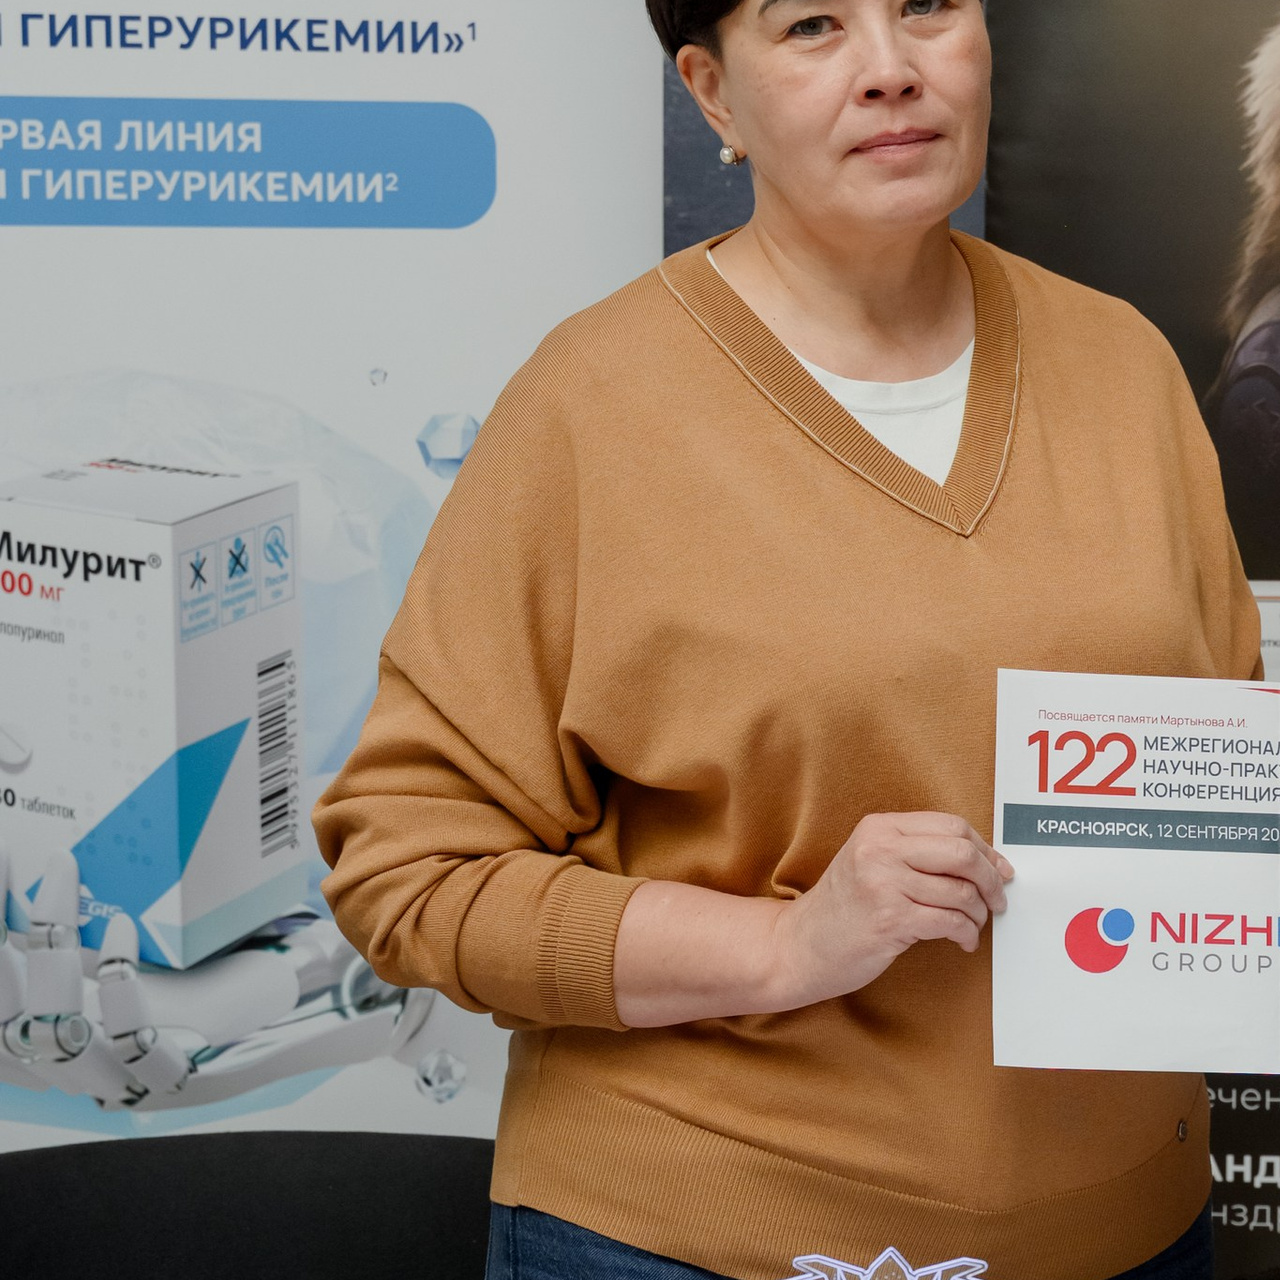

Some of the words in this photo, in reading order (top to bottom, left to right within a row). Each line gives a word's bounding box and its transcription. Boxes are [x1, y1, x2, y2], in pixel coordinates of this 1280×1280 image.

[115, 122, 262, 153] ЛИНИЯ
[1038, 709, 1115, 726] Посвящается
[1116, 713, 1160, 727] памяти
[1160, 714, 1224, 730] Мартынова
[1226, 717, 1249, 729] А.И.
[1027, 729, 1137, 797] 122
[0, 787, 16, 807] 0
[20, 795, 77, 821] таблеток
[1036, 818, 1154, 841] КРАСНОЯРСК,
[1157, 823, 1174, 838] 12
[1175, 823, 1258, 842] СЕНТЯБРЯ
[1151, 951, 1274, 974] GROUP
